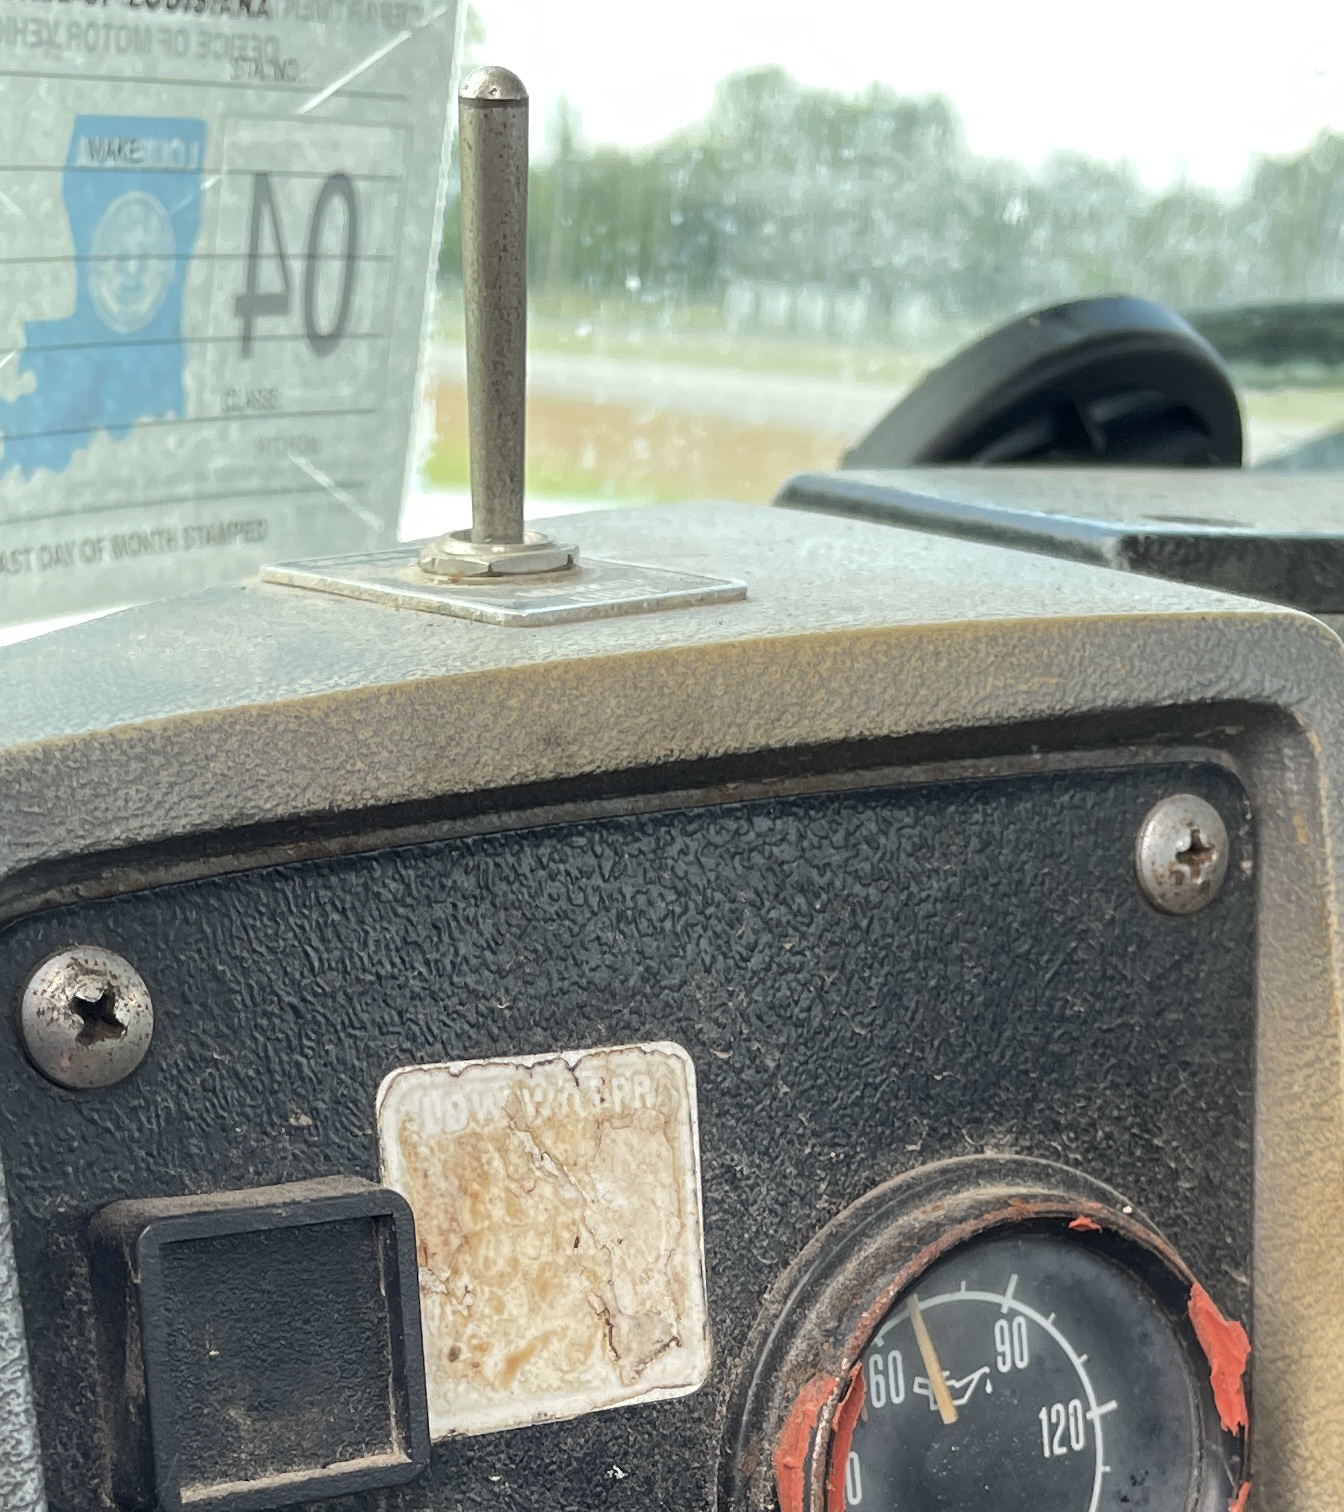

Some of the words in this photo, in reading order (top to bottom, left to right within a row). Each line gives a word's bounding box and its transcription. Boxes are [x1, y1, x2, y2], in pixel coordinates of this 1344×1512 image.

[38, 540, 75, 571] DAY
[77, 536, 106, 562] OF
[110, 527, 177, 559] MONTH
[994, 1315, 1029, 1373] 90
[869, 1350, 905, 1409] 60
[1038, 1398, 1086, 1458] 120
